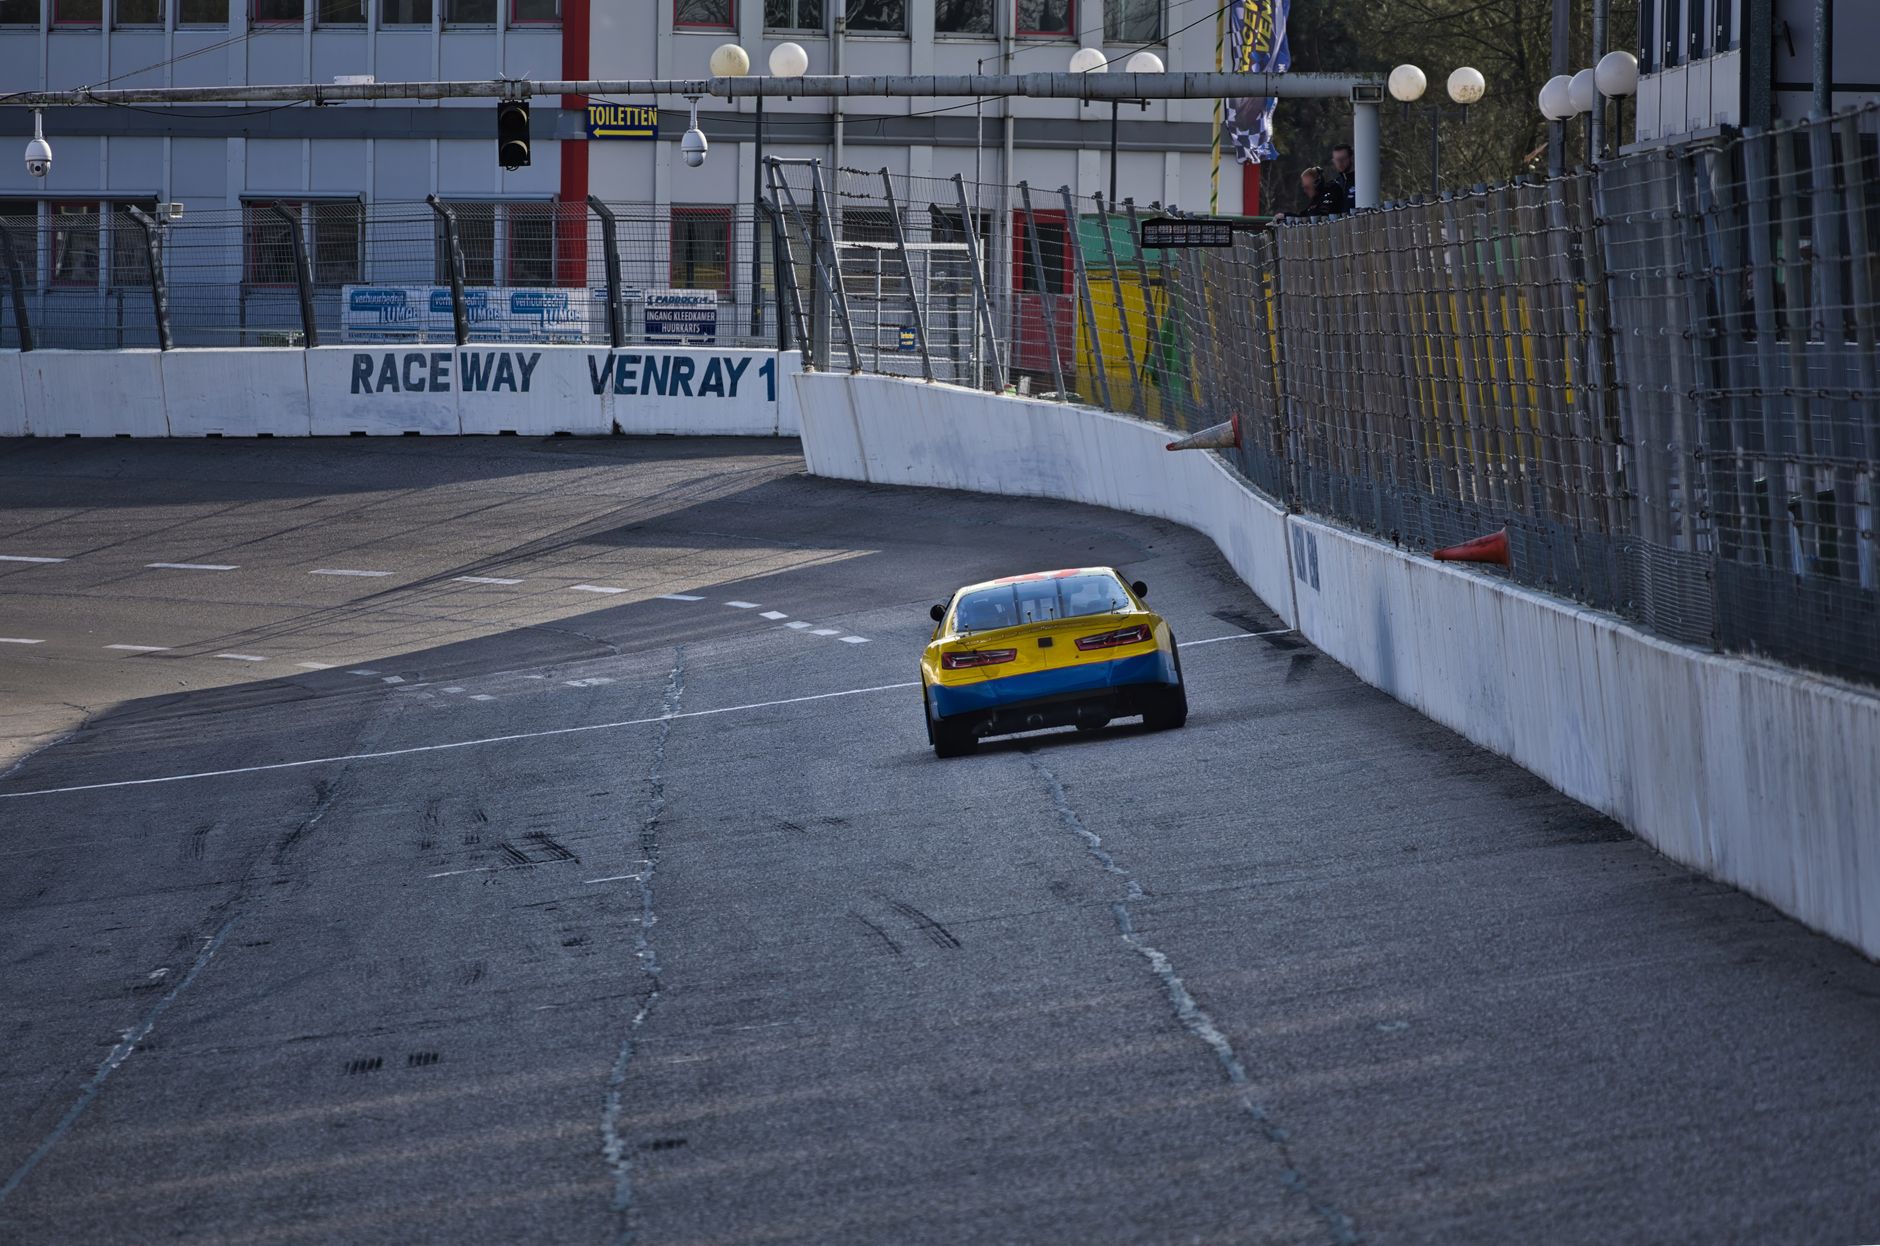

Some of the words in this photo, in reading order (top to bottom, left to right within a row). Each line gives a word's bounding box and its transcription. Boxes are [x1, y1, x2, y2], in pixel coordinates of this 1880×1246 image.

[1237, 0, 1258, 72] ACE
[588, 106, 657, 126] TOILETTEN
[647, 311, 673, 321] INGANG
[674, 311, 715, 321] KLEEDKAMER
[661, 323, 701, 333] HUURKARTS
[350, 352, 542, 394] RACEWAY
[588, 354, 752, 397] VENRAY
[758, 357, 776, 401] 1
